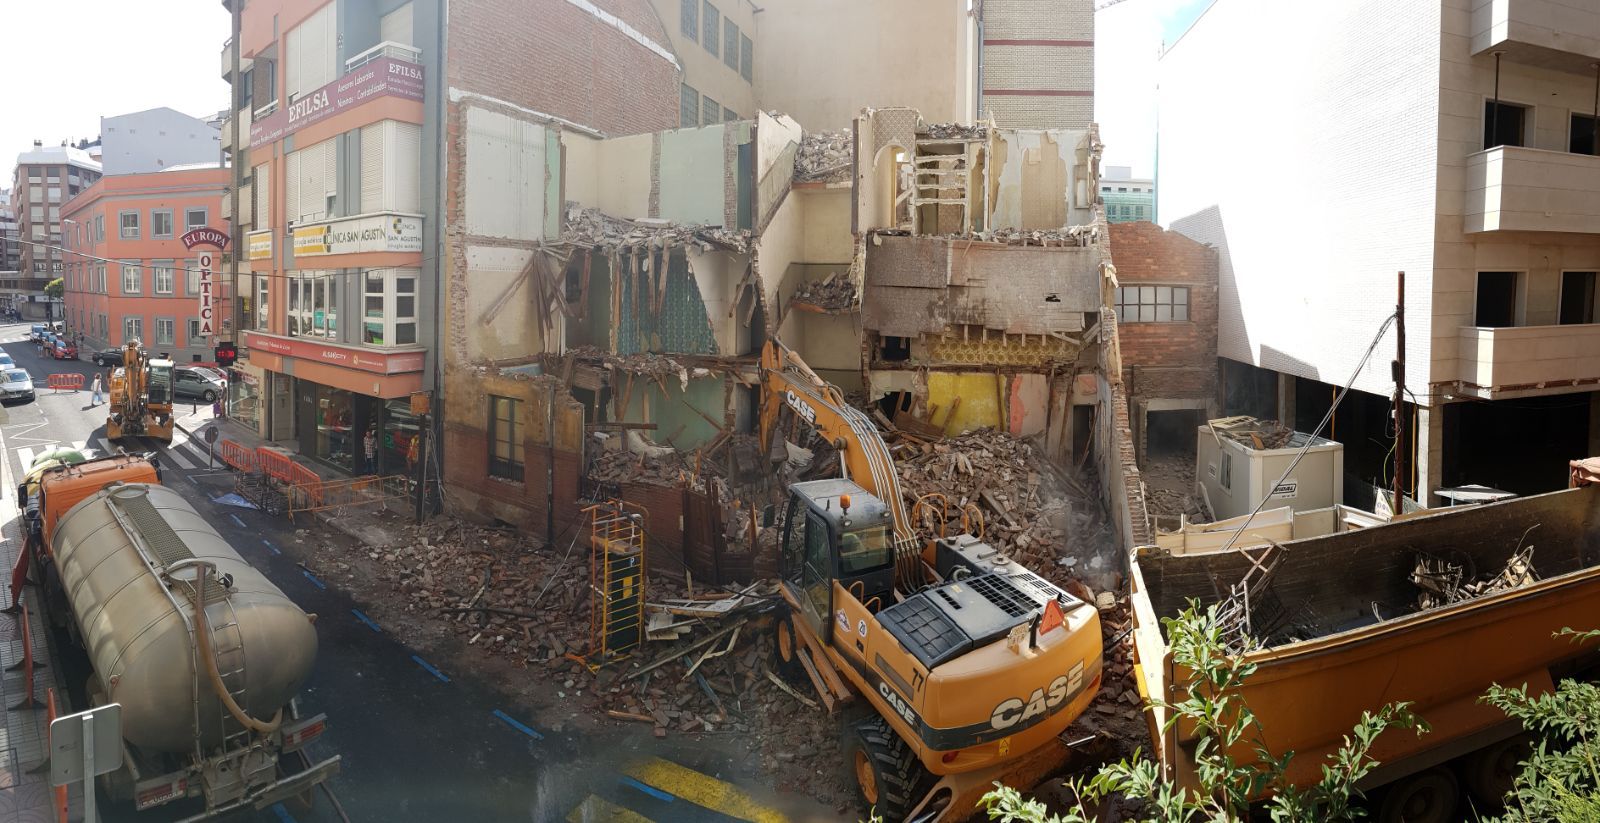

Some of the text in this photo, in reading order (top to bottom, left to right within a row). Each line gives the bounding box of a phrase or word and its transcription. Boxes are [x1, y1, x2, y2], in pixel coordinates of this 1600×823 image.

[389, 63, 423, 80] EFILSA
[288, 89, 330, 124] EFILSA
[184, 231, 226, 247] EUROPA
[346, 230, 359, 243] SAN
[200, 255, 212, 333] OPTICA
[787, 390, 816, 423] CASE
[912, 667, 924, 692] 77
[990, 659, 1085, 731] CASE
[880, 682, 915, 726] CASE
